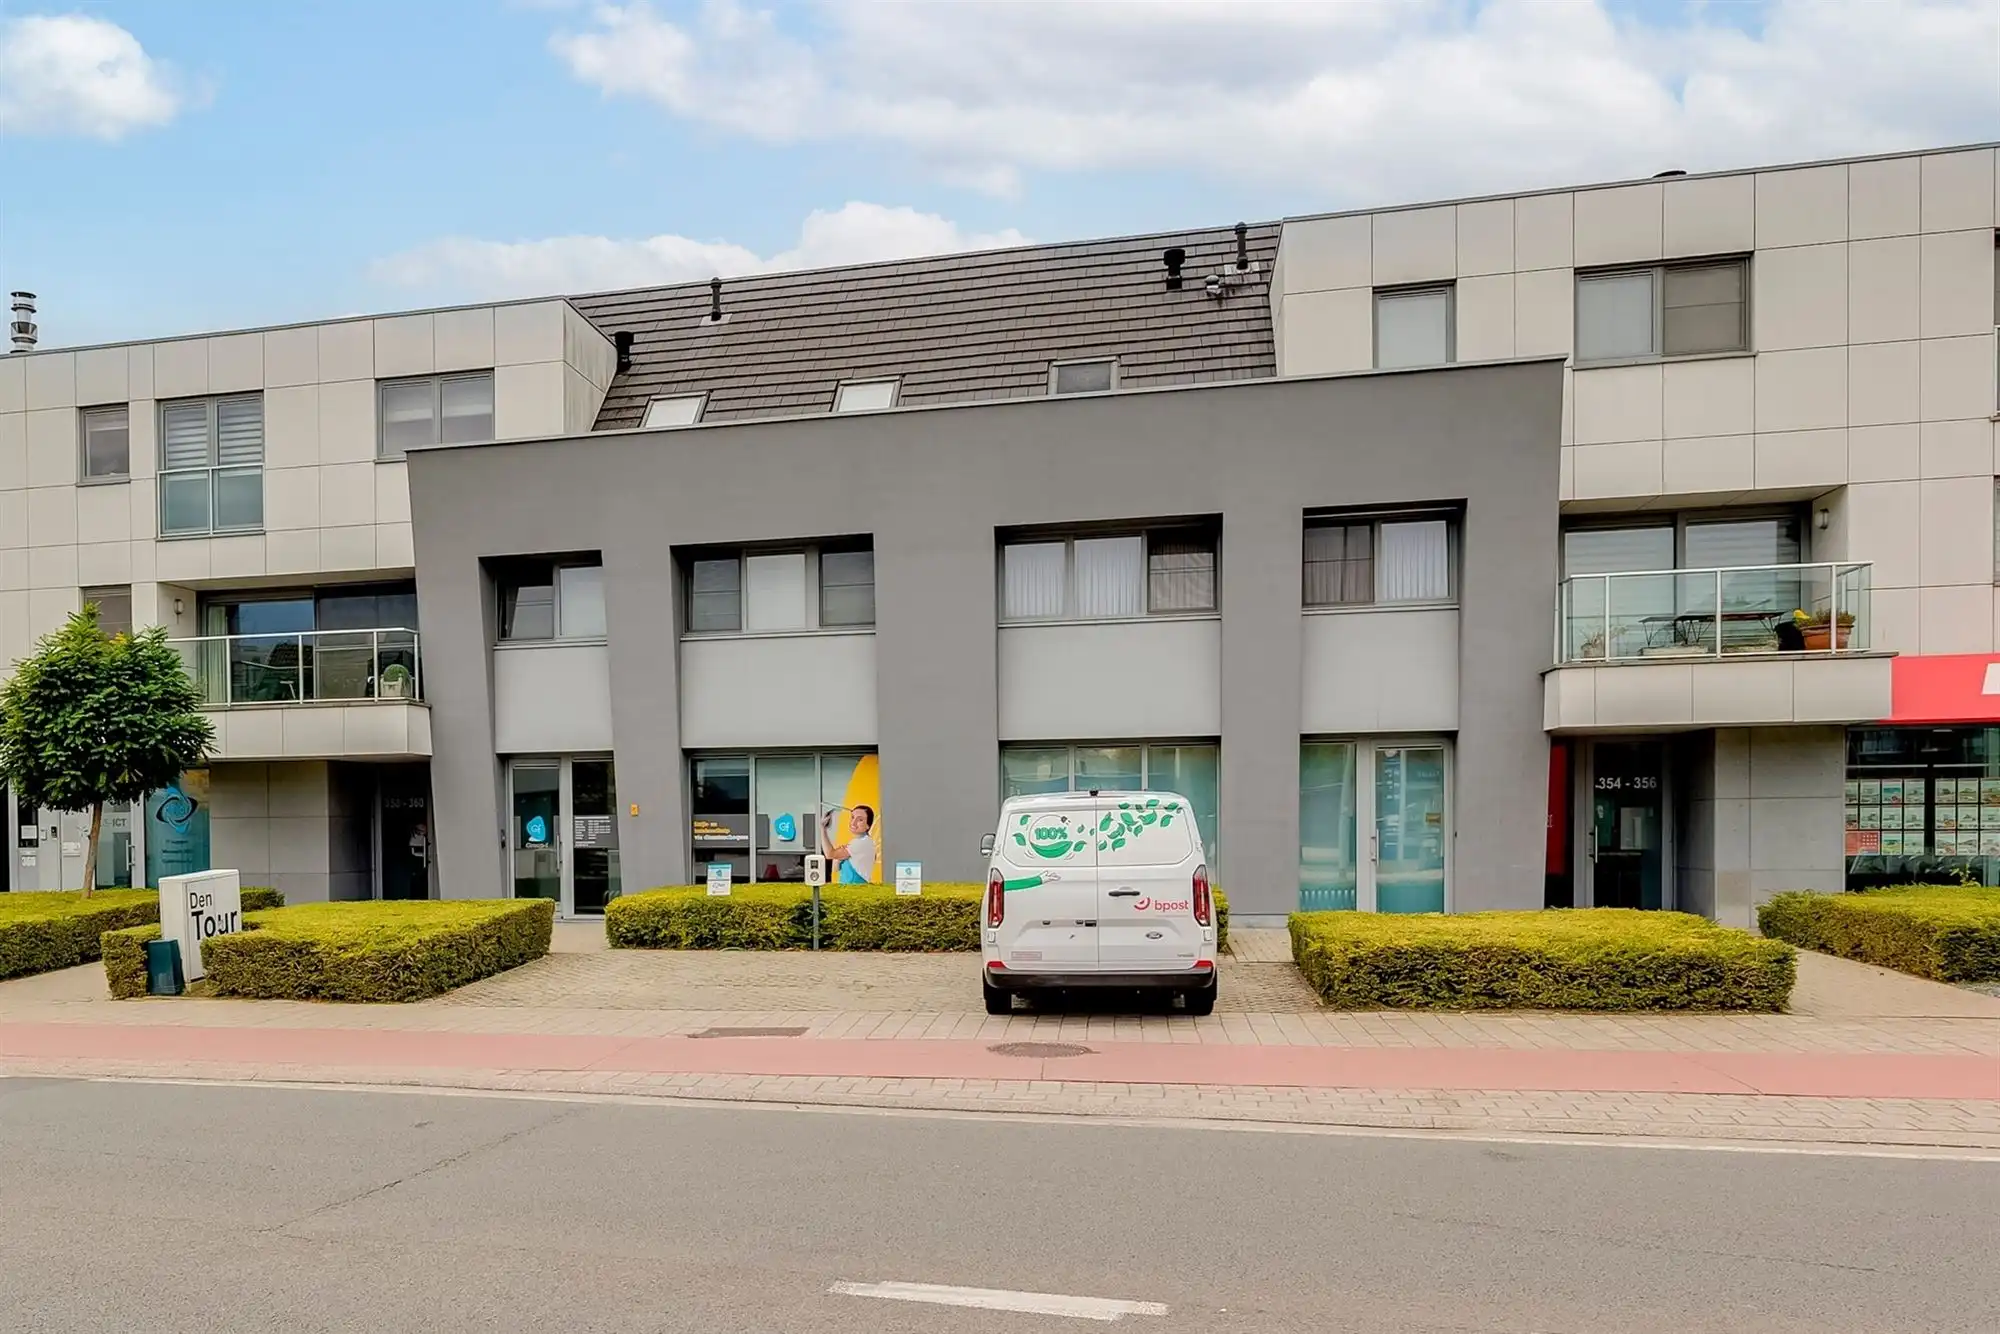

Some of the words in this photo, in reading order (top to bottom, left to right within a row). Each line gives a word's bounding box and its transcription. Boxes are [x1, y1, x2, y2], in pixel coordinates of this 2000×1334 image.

[1599, 777, 1621, 790] 354
[1633, 776, 1657, 789] 356
[1034, 826, 1068, 841] 100%
[189, 891, 213, 909] Den
[1154, 899, 1189, 913] bpost
[190, 909, 238, 941] Tour
